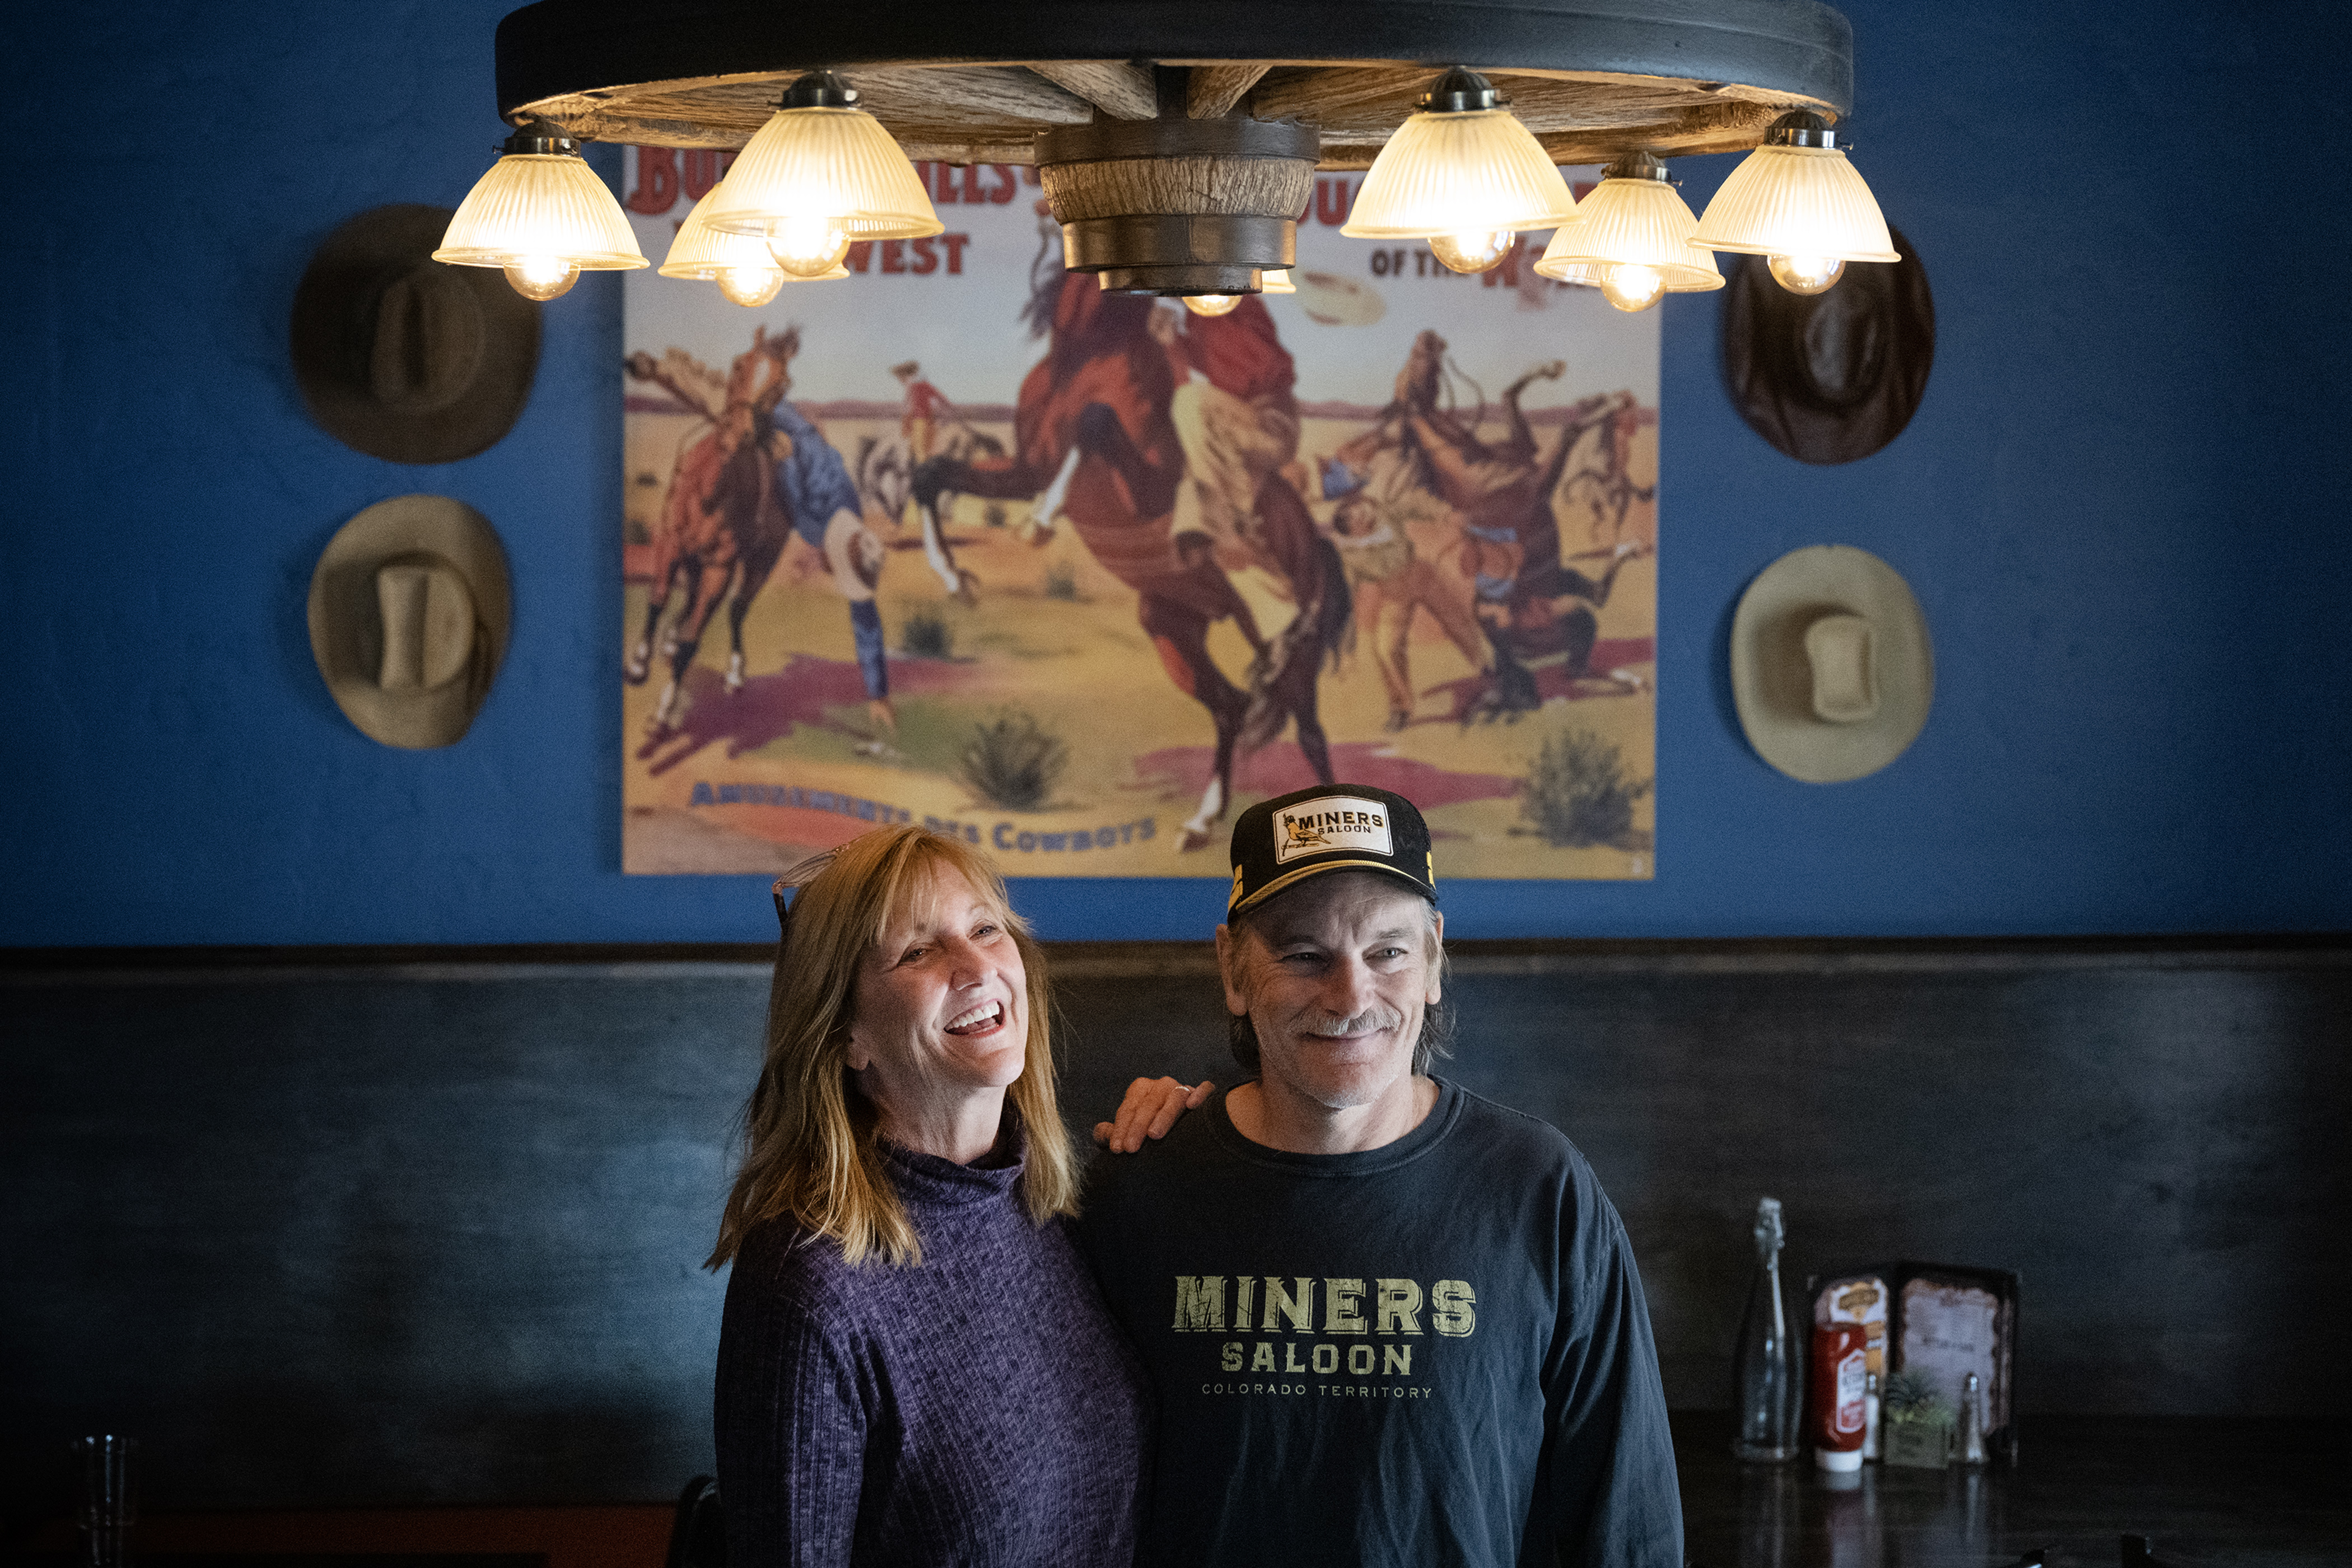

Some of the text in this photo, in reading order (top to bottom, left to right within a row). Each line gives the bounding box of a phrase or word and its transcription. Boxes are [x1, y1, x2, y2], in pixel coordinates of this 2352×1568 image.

[1371, 249, 1406, 277] OF
[1298, 811, 1384, 830] MINERS
[1317, 824, 1371, 836] SALOON
[1171, 1275, 1477, 1338] MINERS
[1221, 1342, 1412, 1376] SALOON
[1201, 1383, 1432, 1399] COLORADO TERRITORY
